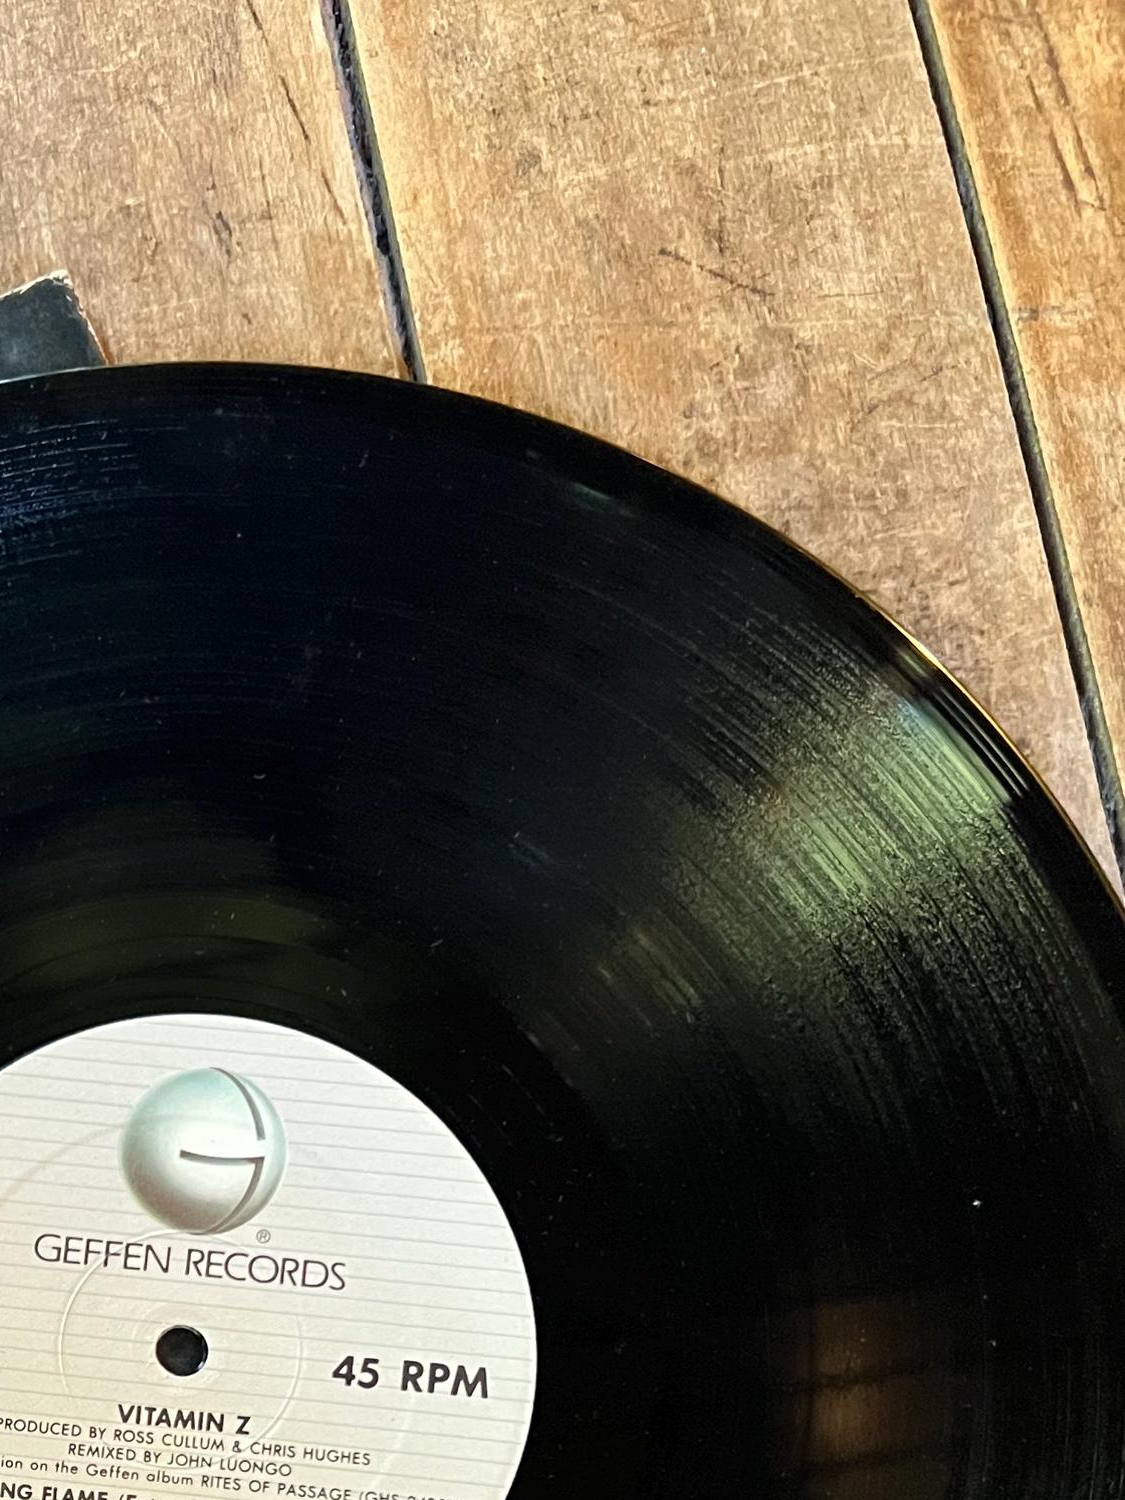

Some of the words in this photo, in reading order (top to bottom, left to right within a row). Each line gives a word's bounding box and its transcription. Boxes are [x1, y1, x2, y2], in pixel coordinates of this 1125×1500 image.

[33, 1232, 173, 1275] GEFFEN
[183, 1246, 347, 1293] RECORDS
[332, 1354, 381, 1391] 45
[399, 1358, 491, 1400] RPM
[117, 1403, 225, 1434] VITAMIN
[235, 1415, 252, 1436] Z
[67, 1442, 137, 1462] REMIXED
[143, 1450, 162, 1465] BY
[167, 1453, 212, 1469] JOHN
[219, 1457, 293, 1478] LUONGO
[88, 1426, 107, 1440] BY
[113, 1429, 155, 1446] ROSS
[161, 1433, 225, 1452] CULLUM
[232, 1440, 242, 1454] &
[249, 1441, 296, 1460] CHRIS
[302, 1447, 372, 1467] HUGHES
[30, 1460, 49, 1473] on
[55, 1460, 79, 1476] the
[86, 1463, 140, 1482] Geffen
[146, 1470, 194, 1487] album
[200, 1475, 242, 1492] RITES
[248, 1479, 271, 1495] OF
